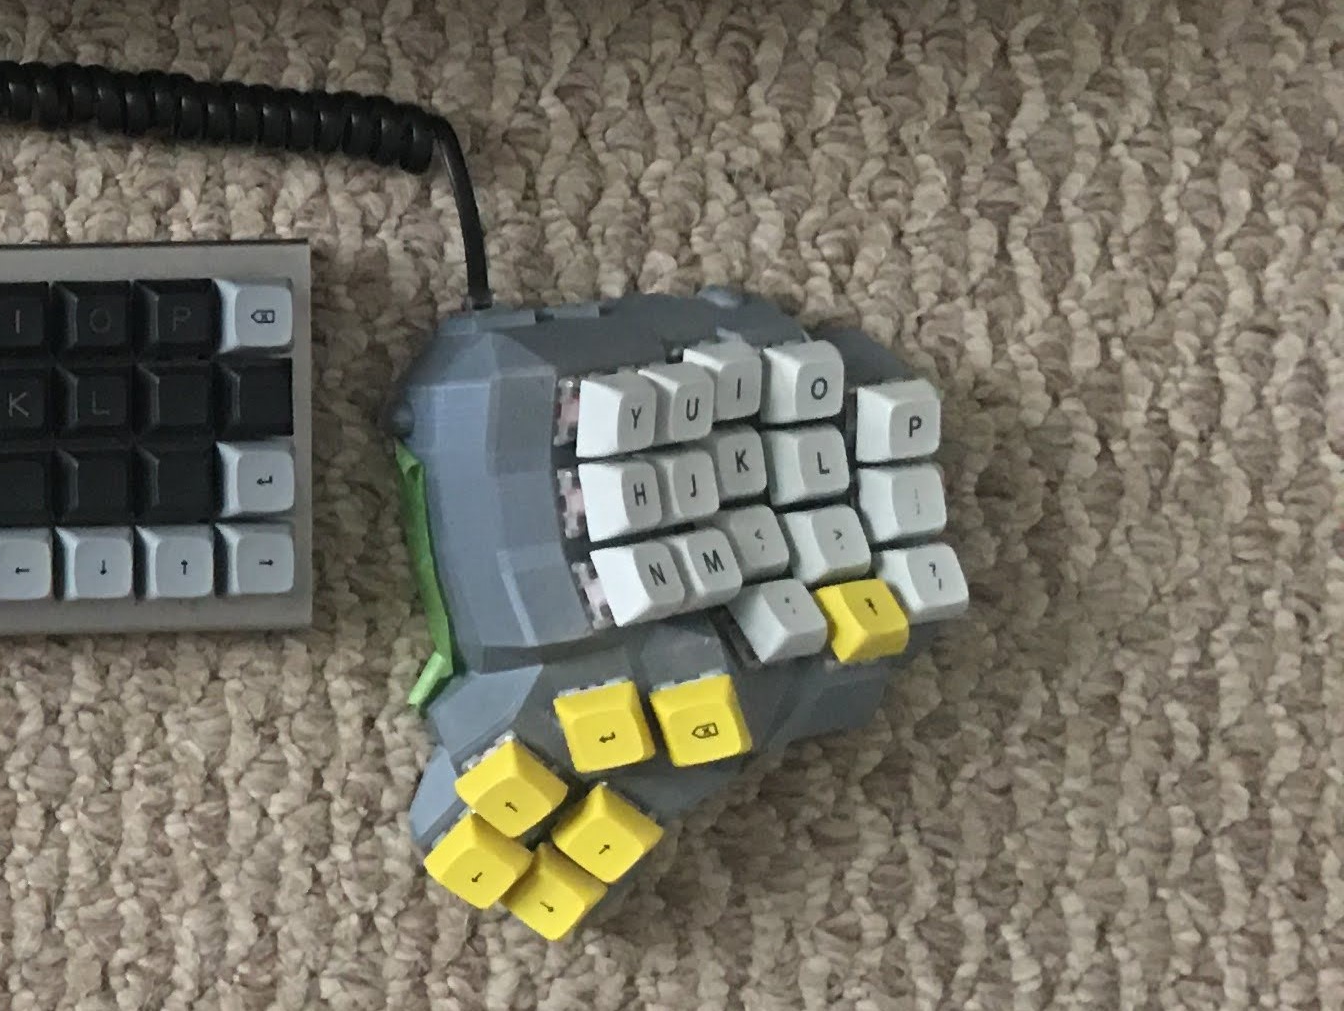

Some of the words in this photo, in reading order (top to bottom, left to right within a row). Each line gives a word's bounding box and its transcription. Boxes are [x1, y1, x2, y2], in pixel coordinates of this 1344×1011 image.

[89, 307, 113, 334] O
[172, 306, 192, 332] P
[8, 391, 30, 418] K
[91, 390, 111, 416] L
[630, 406, 643, 430] Y
[685, 397, 700, 422] U
[810, 376, 829, 401] O
[908, 415, 923, 438] P
[633, 482, 648, 507] H
[688, 474, 699, 498] J
[734, 449, 750, 474] K
[816, 451, 831, 475] L
[648, 562, 667, 587] N
[701, 549, 725, 574] M
